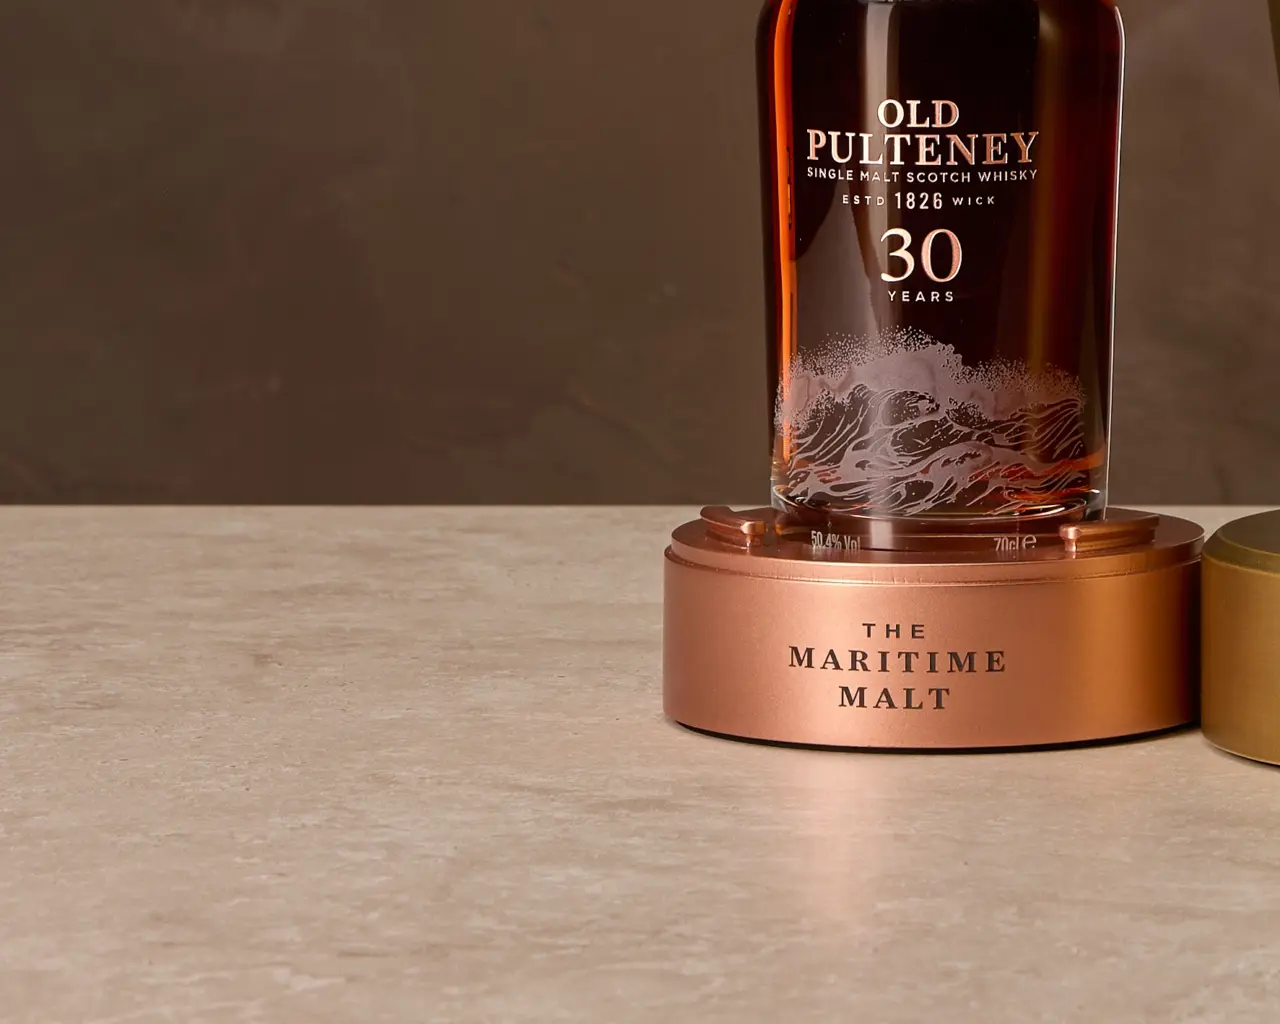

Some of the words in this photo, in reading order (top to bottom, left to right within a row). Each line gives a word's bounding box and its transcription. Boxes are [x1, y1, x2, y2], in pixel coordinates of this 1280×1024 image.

[877, 98, 960, 128] OLD
[806, 128, 1039, 166] PULTENEY
[807, 166, 854, 181] SINGLE
[860, 170, 900, 183] MALT
[906, 171, 971, 183] SCOTCH
[978, 169, 1038, 182] WHISKY
[842, 194, 885, 206] ESTD
[894, 191, 943, 210] 1826
[952, 195, 995, 206] WICK
[880, 227, 963, 283] 30
[888, 290, 954, 302] YEARS
[862, 623, 925, 639] THE
[788, 645, 1006, 674] MARITIME
[838, 685, 950, 710] MALT
